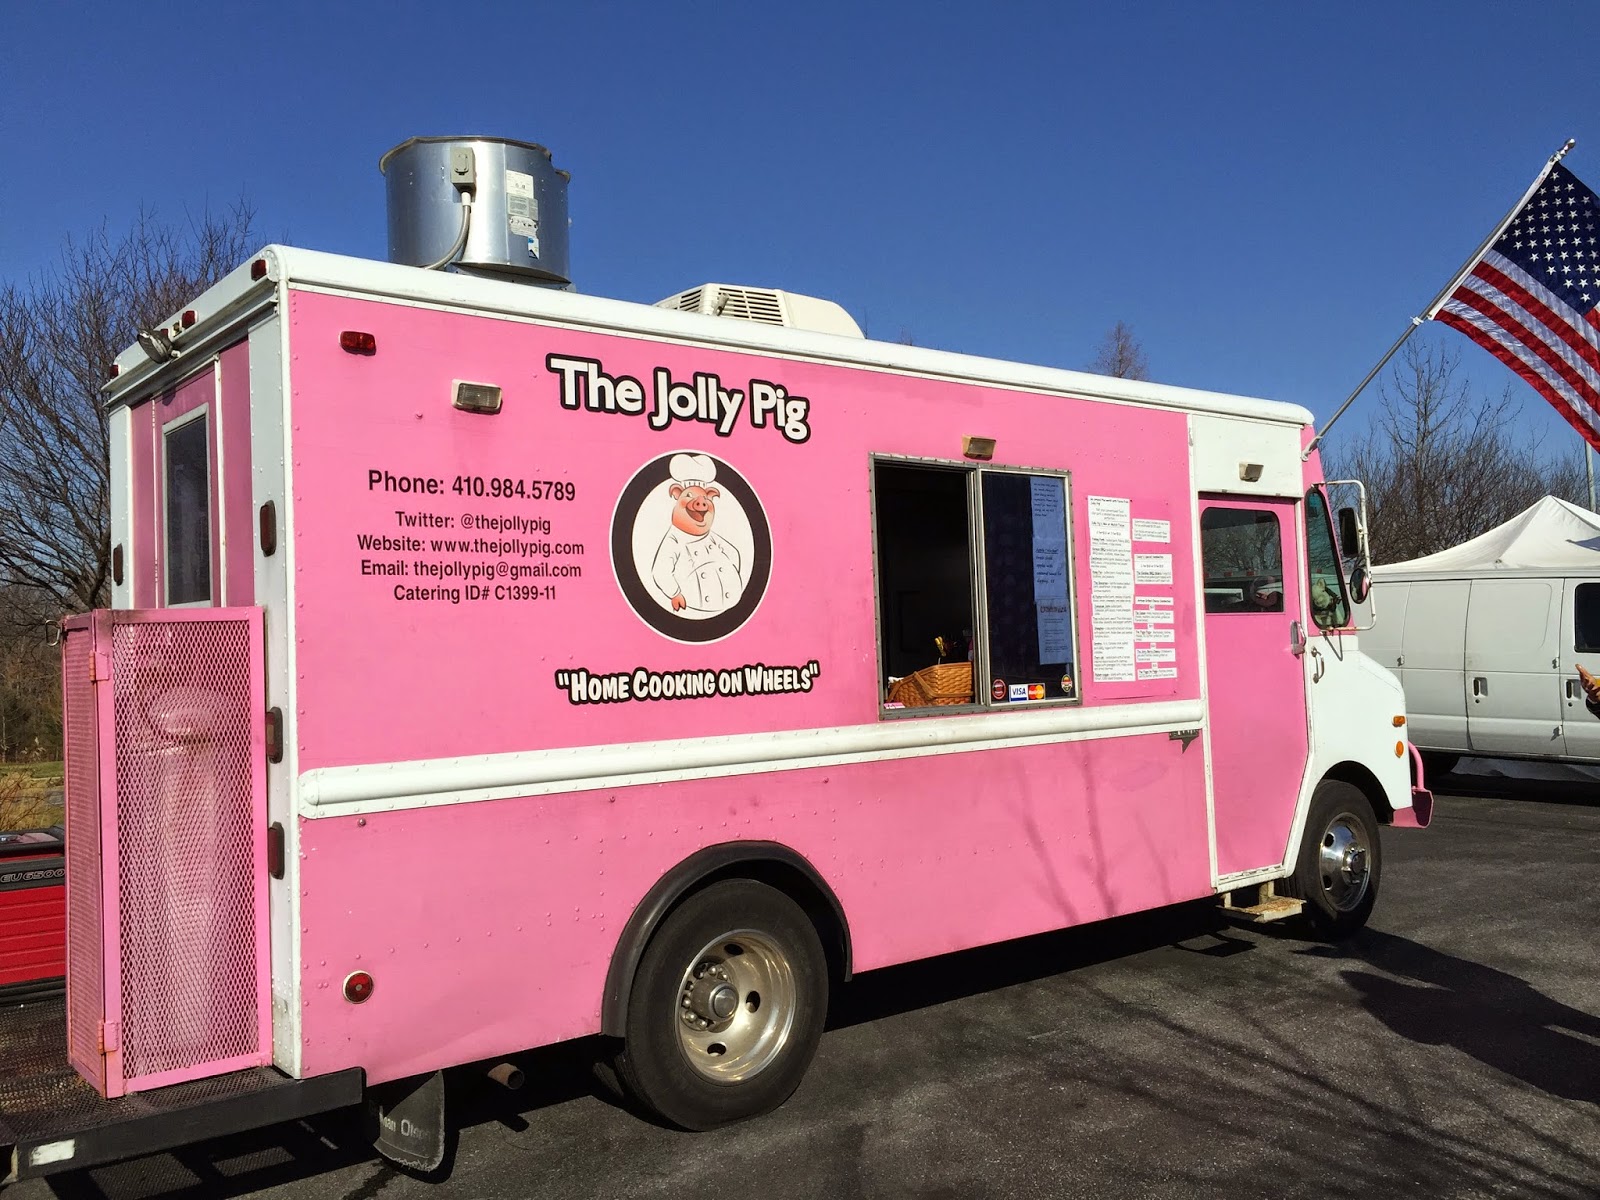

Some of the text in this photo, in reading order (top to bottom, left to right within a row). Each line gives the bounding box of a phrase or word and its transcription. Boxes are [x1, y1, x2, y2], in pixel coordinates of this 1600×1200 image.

[547, 354, 811, 444] The Jolly Pig
[369, 470, 576, 501] Phone: 410.984.5789
[395, 511, 551, 535] Twitter: @thejollypig
[357, 534, 585, 558] Website: www.thejollypig.com
[362, 560, 582, 580] Email: thejollypig@gmail.com
[394, 585, 556, 604] Catering ID# C1399-11
[1012, 687, 1026, 696] VISA
